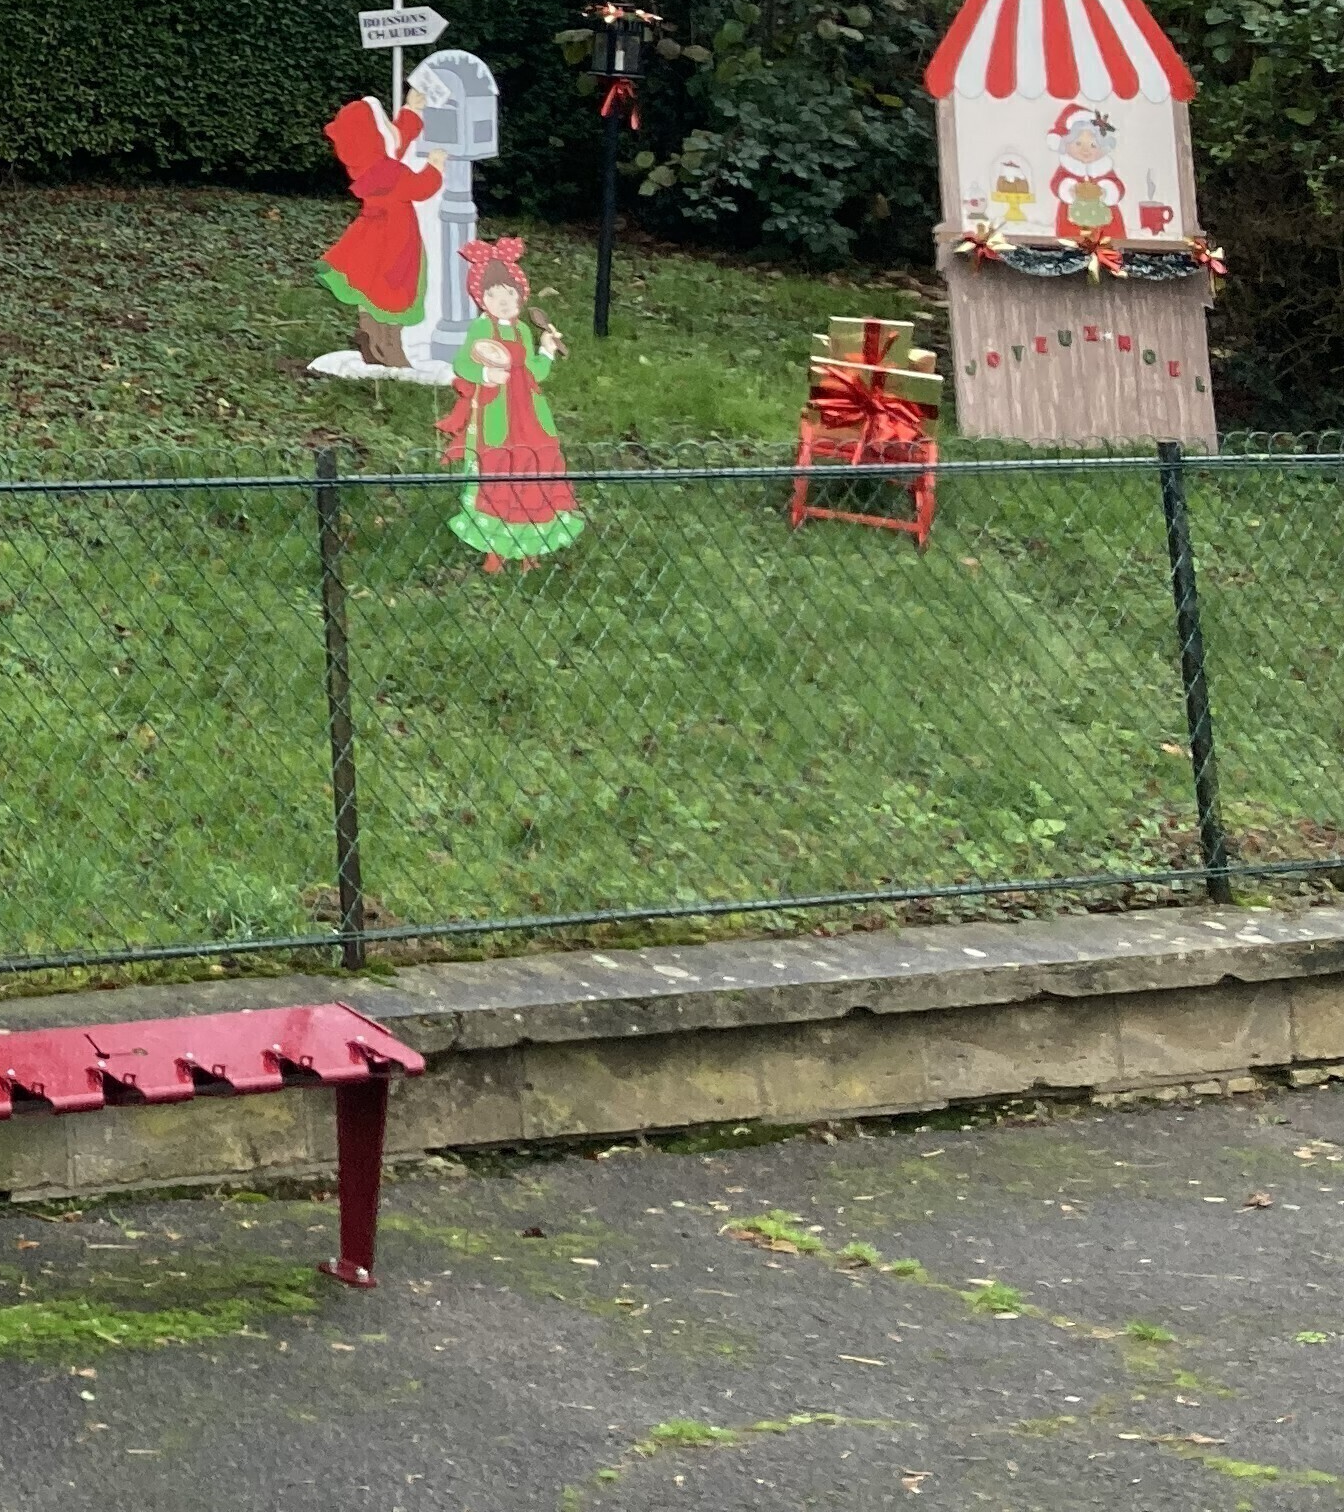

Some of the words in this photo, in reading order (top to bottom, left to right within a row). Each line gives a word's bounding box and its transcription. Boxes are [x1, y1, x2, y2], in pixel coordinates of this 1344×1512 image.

[363, 14, 427, 28] BOISSONS
[367, 26, 428, 41] CHAUDES
[965, 325, 1099, 376] JOYEUX
